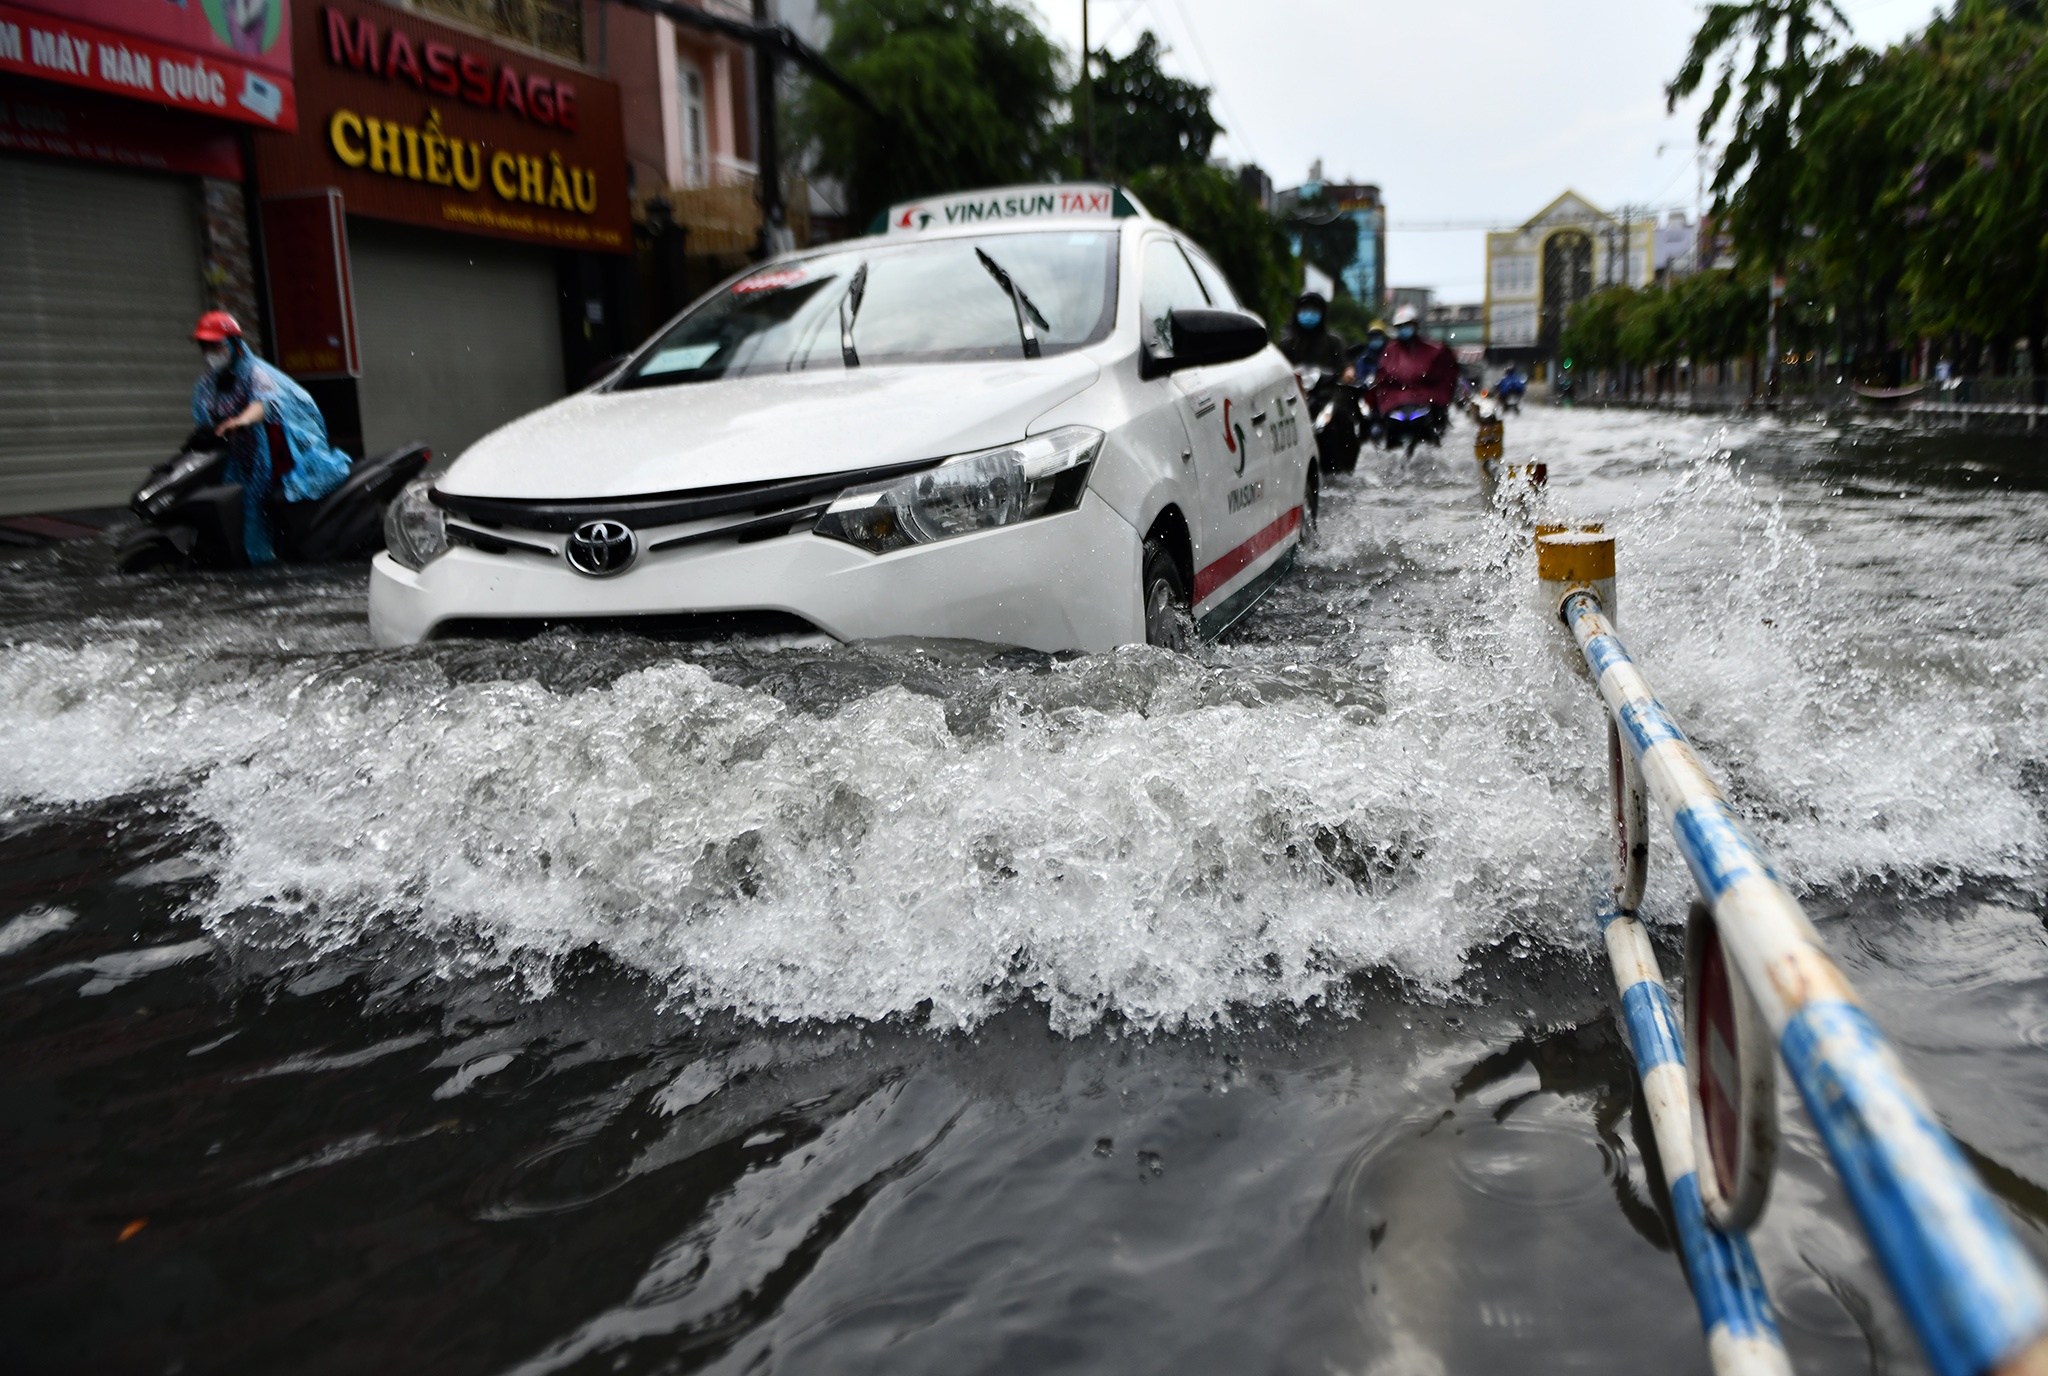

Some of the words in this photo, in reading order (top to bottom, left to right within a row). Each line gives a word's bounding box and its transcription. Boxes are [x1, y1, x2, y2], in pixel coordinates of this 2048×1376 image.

[98, 42, 154, 91] HÀN
[326, 6, 577, 131] MASSAGE
[944, 194, 1054, 225] VINASUN
[1060, 192, 1110, 213] TAXI
